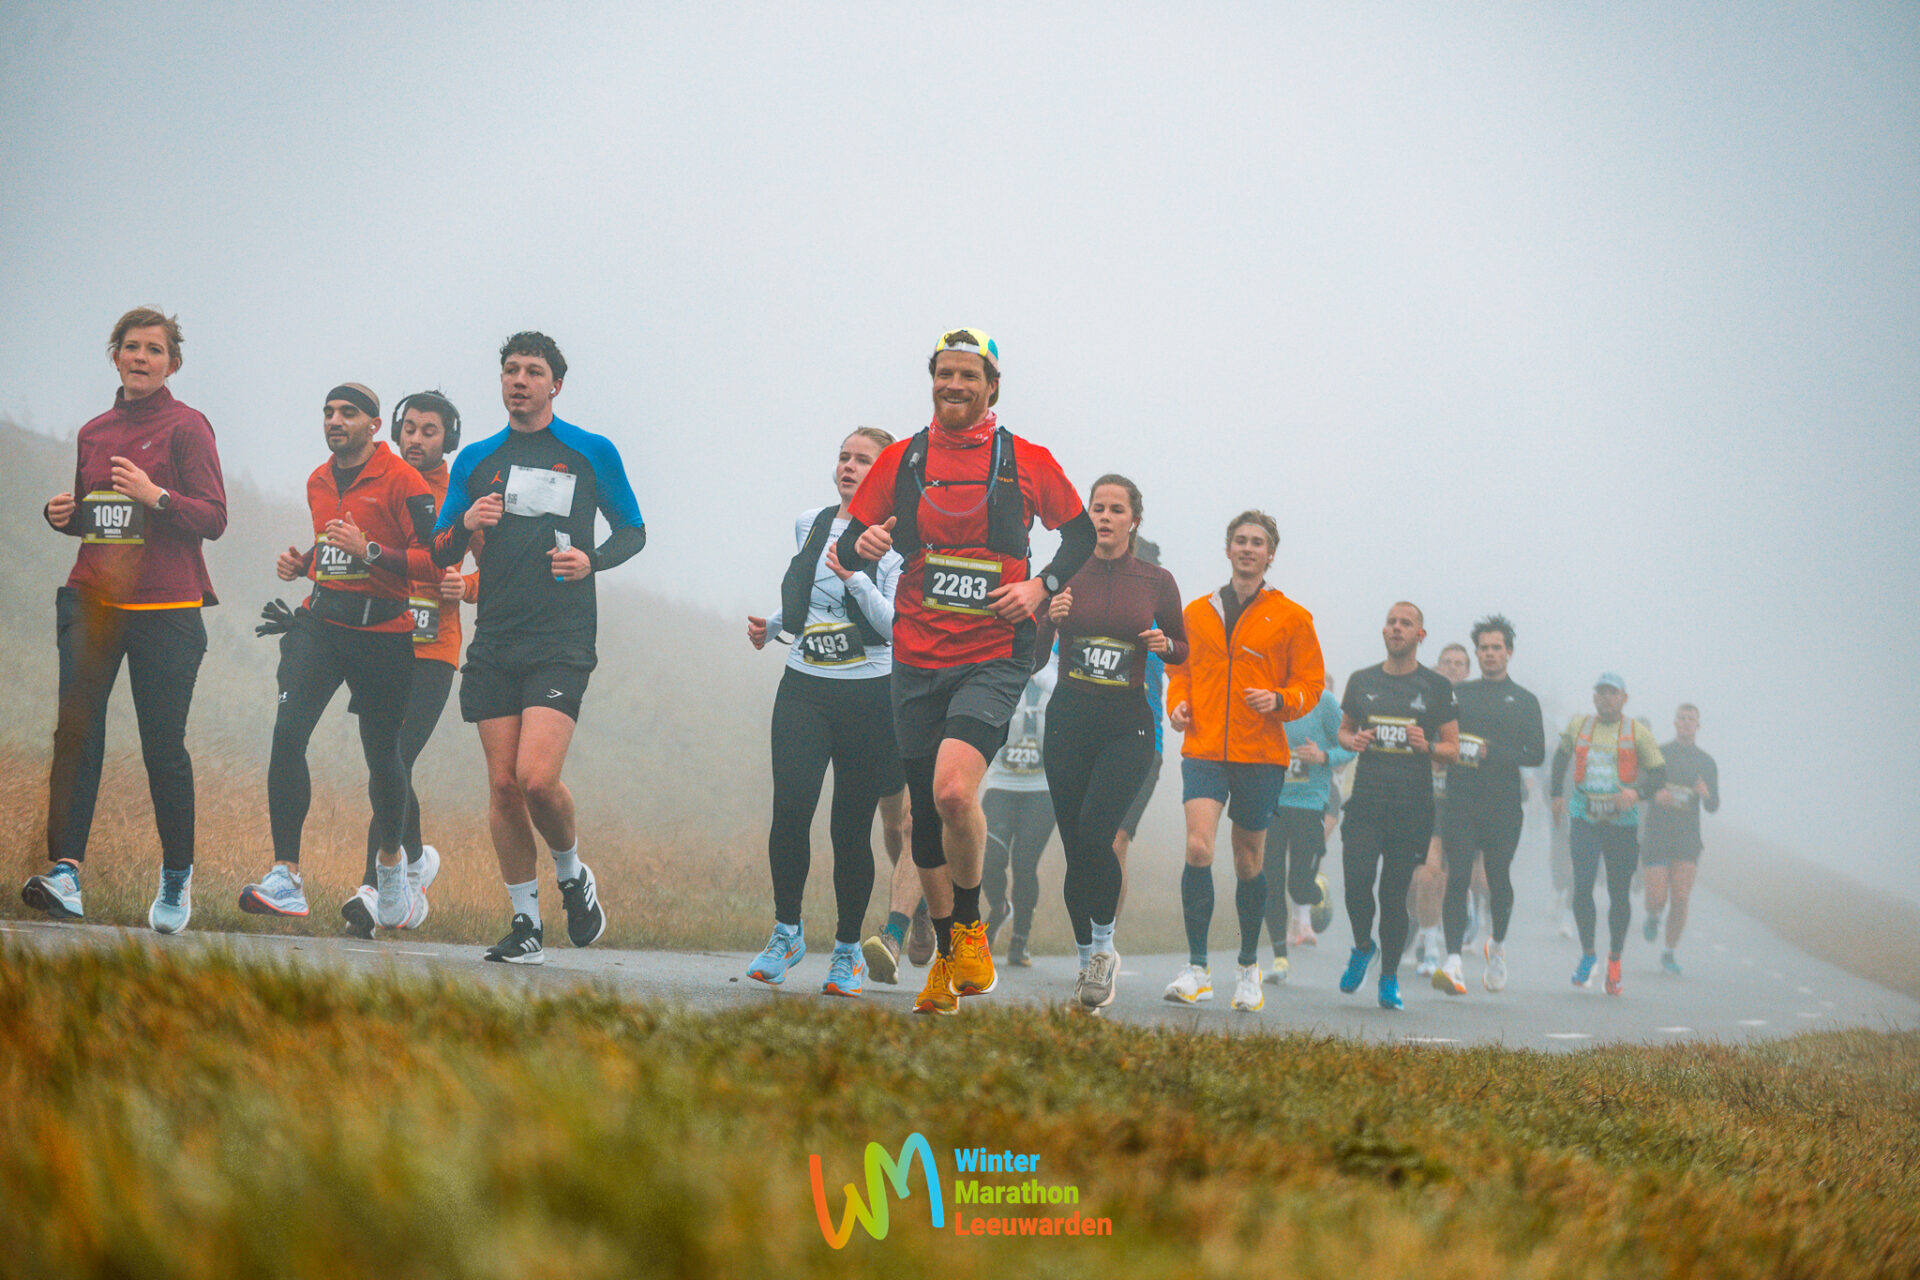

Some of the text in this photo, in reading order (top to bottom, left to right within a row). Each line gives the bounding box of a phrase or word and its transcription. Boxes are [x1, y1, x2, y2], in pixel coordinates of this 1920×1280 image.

[93, 505, 133, 527] 1097
[932, 572, 988, 600] 2283
[805, 633, 849, 654] 1193
[1082, 647, 1121, 670] 1447
[1375, 725, 1406, 742] 1026
